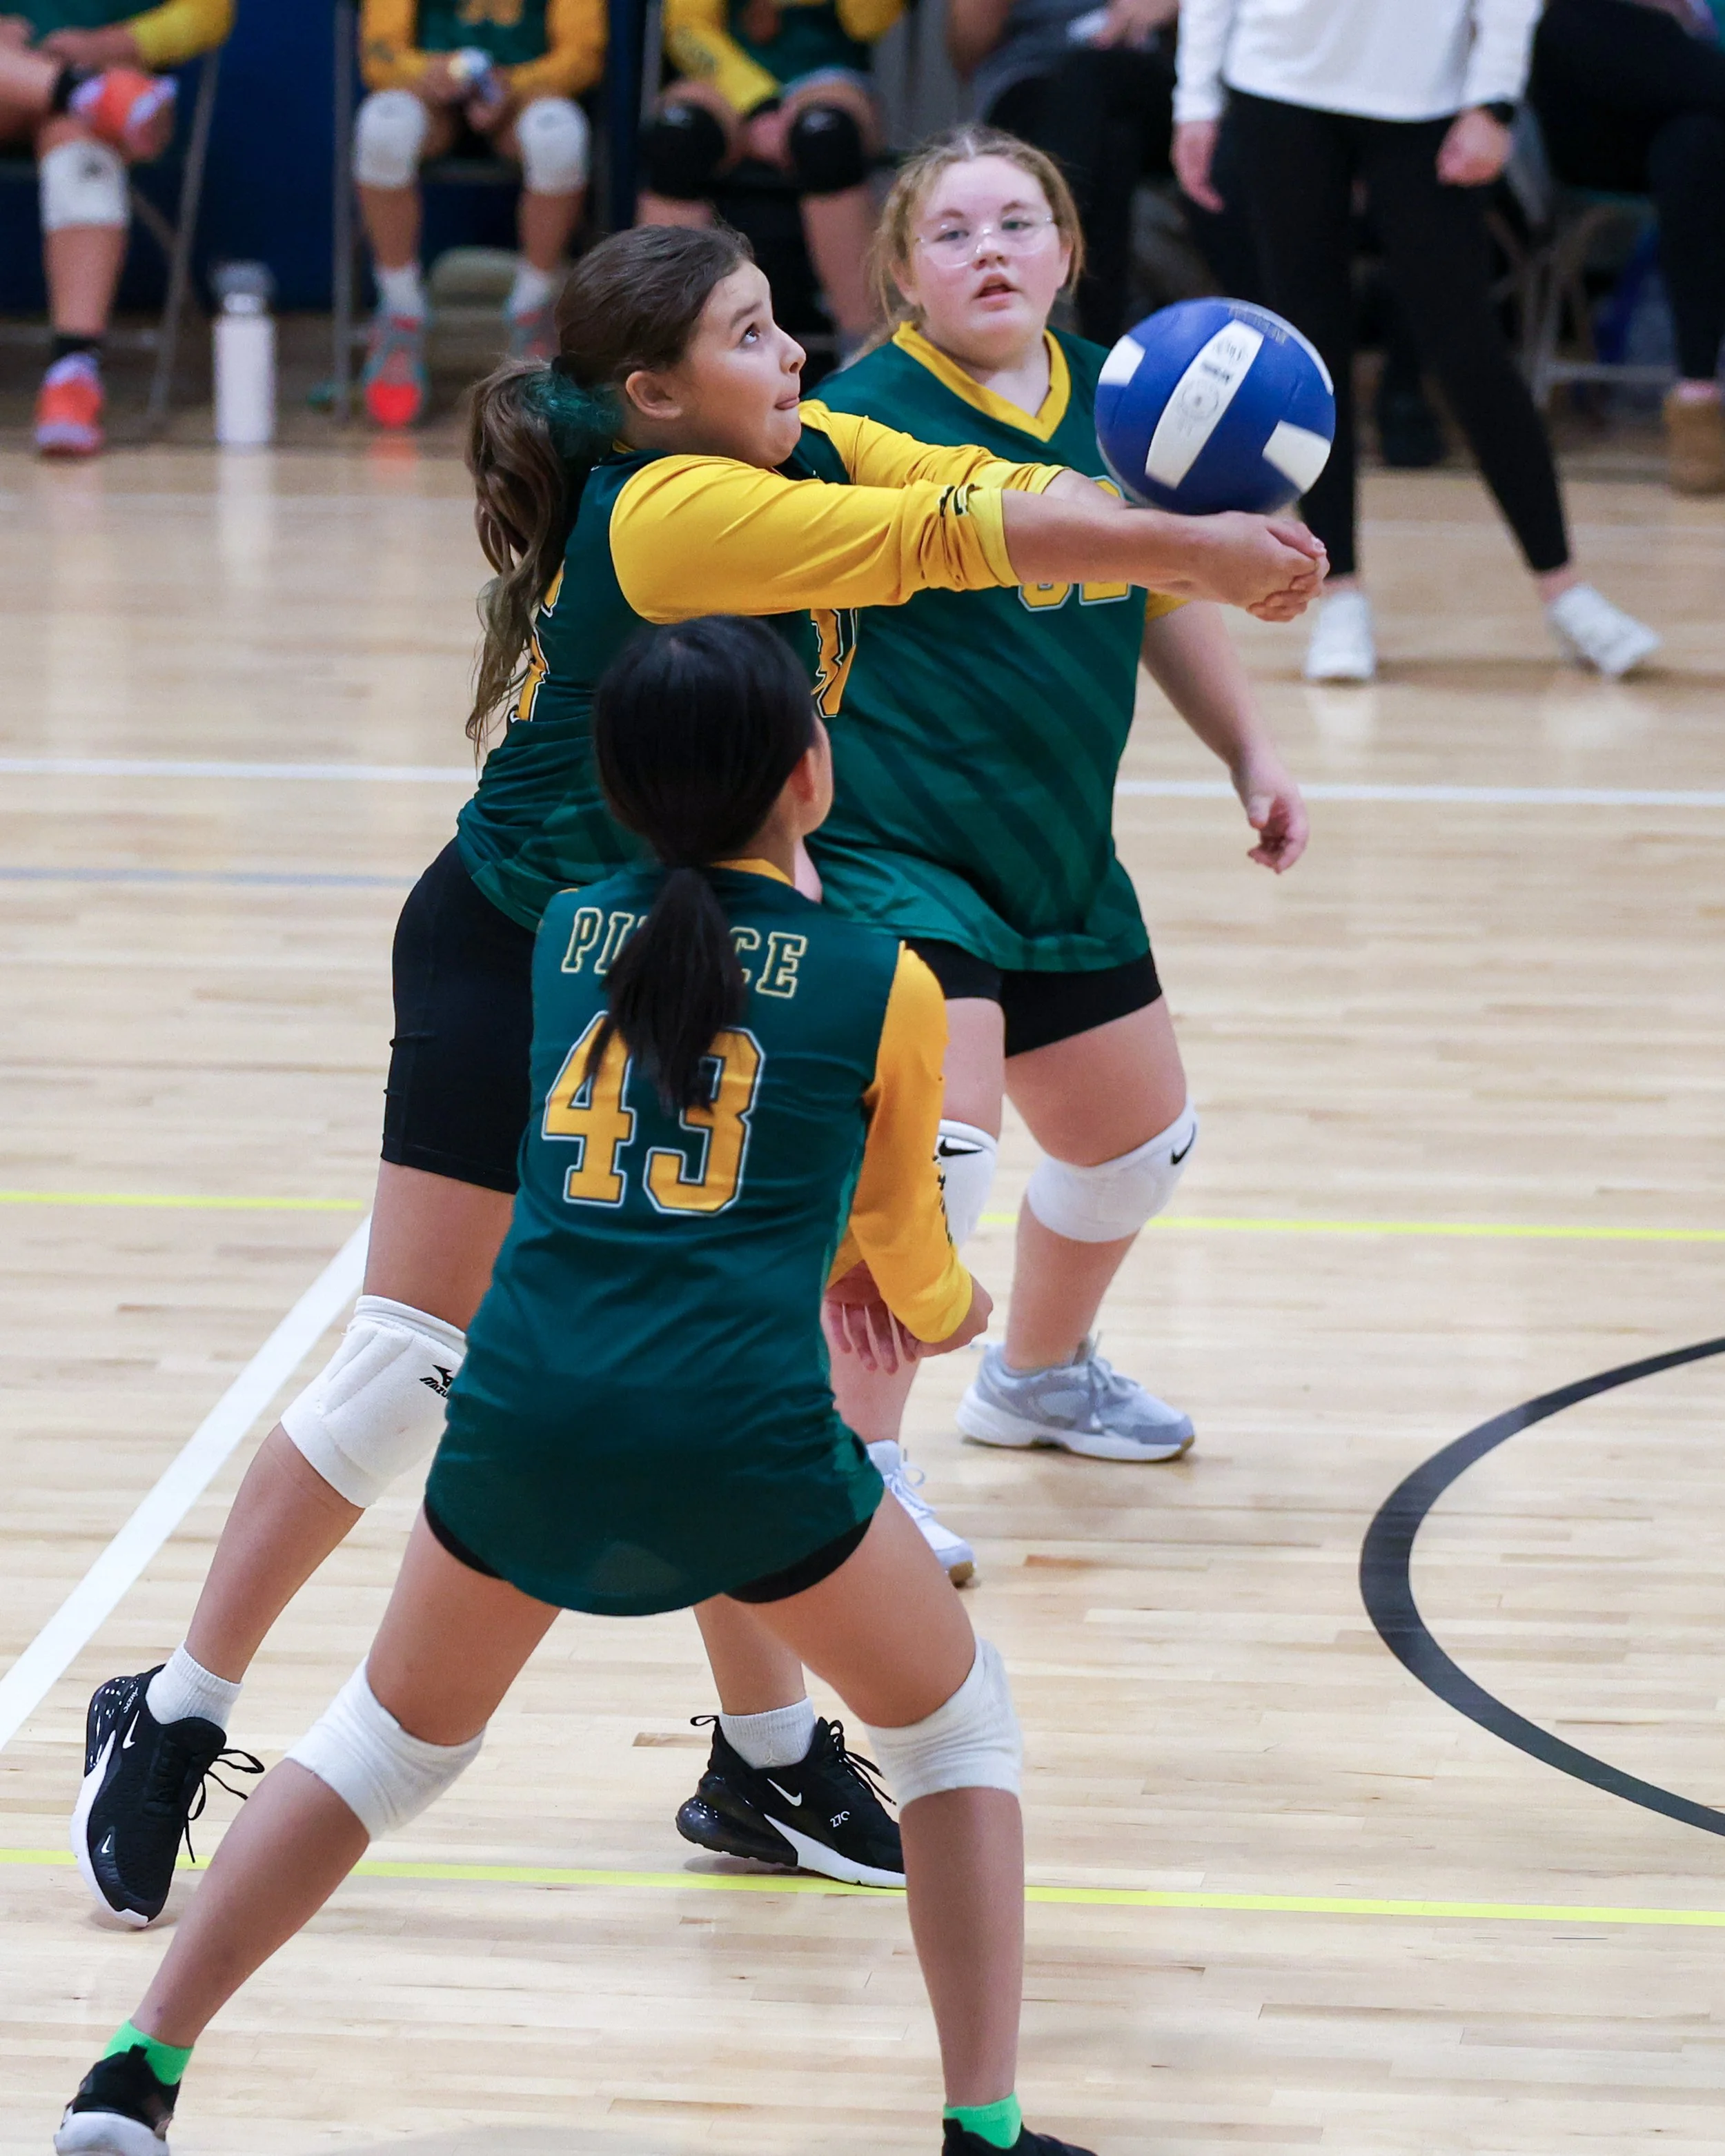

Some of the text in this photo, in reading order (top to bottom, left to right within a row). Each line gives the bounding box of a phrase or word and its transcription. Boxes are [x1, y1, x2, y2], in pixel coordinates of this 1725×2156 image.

[561, 907, 808, 999] PICE
[541, 1009, 766, 1216] 43
[419, 1376, 450, 1400] MIZU
